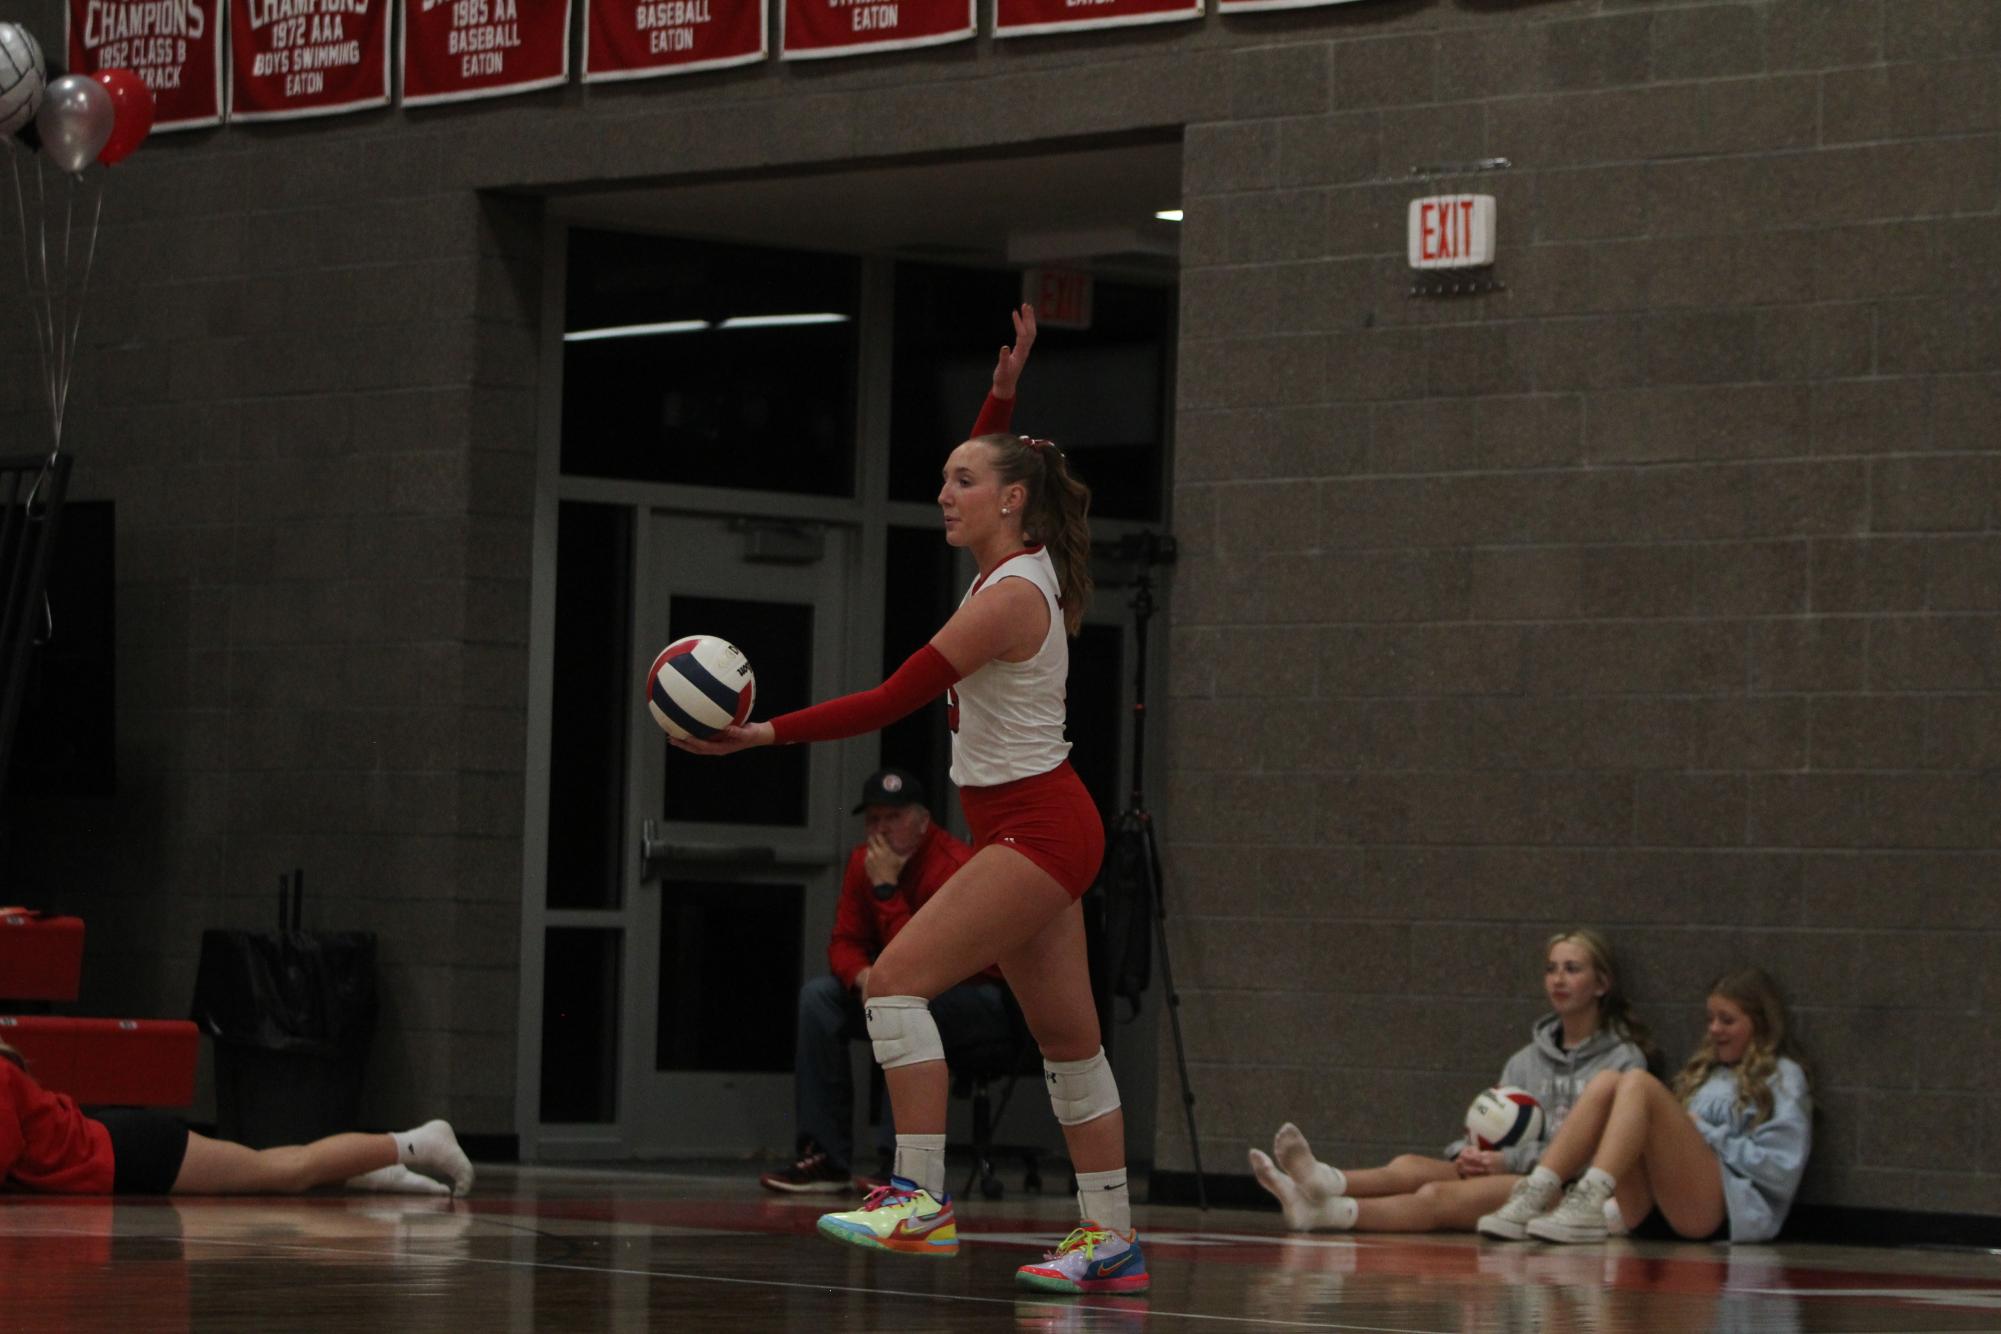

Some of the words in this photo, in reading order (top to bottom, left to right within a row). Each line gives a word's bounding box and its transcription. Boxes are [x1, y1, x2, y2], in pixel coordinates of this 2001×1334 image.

[84, 0, 205, 50] CHAMPIONS
[452, 0, 489, 29] 1985
[494, 0, 518, 22] AA
[635, 0, 711, 31] BASEBALL
[852, 4, 899, 32] EATON
[271, 16, 306, 49] 1972
[310, 14, 344, 45] AAA
[448, 22, 521, 55] BASEBALL
[650, 27, 694, 55] EATON
[98, 41, 128, 69] 1952
[131, 36, 173, 67] CLASS
[177, 39, 187, 65] B
[252, 50, 289, 77] BOYS
[292, 40, 361, 72] SWIMMING
[461, 51, 503, 78] EATON
[285, 71, 324, 97] EATON
[1421, 201, 1473, 260] EXIT
[1040, 271, 1087, 320] EXIT
